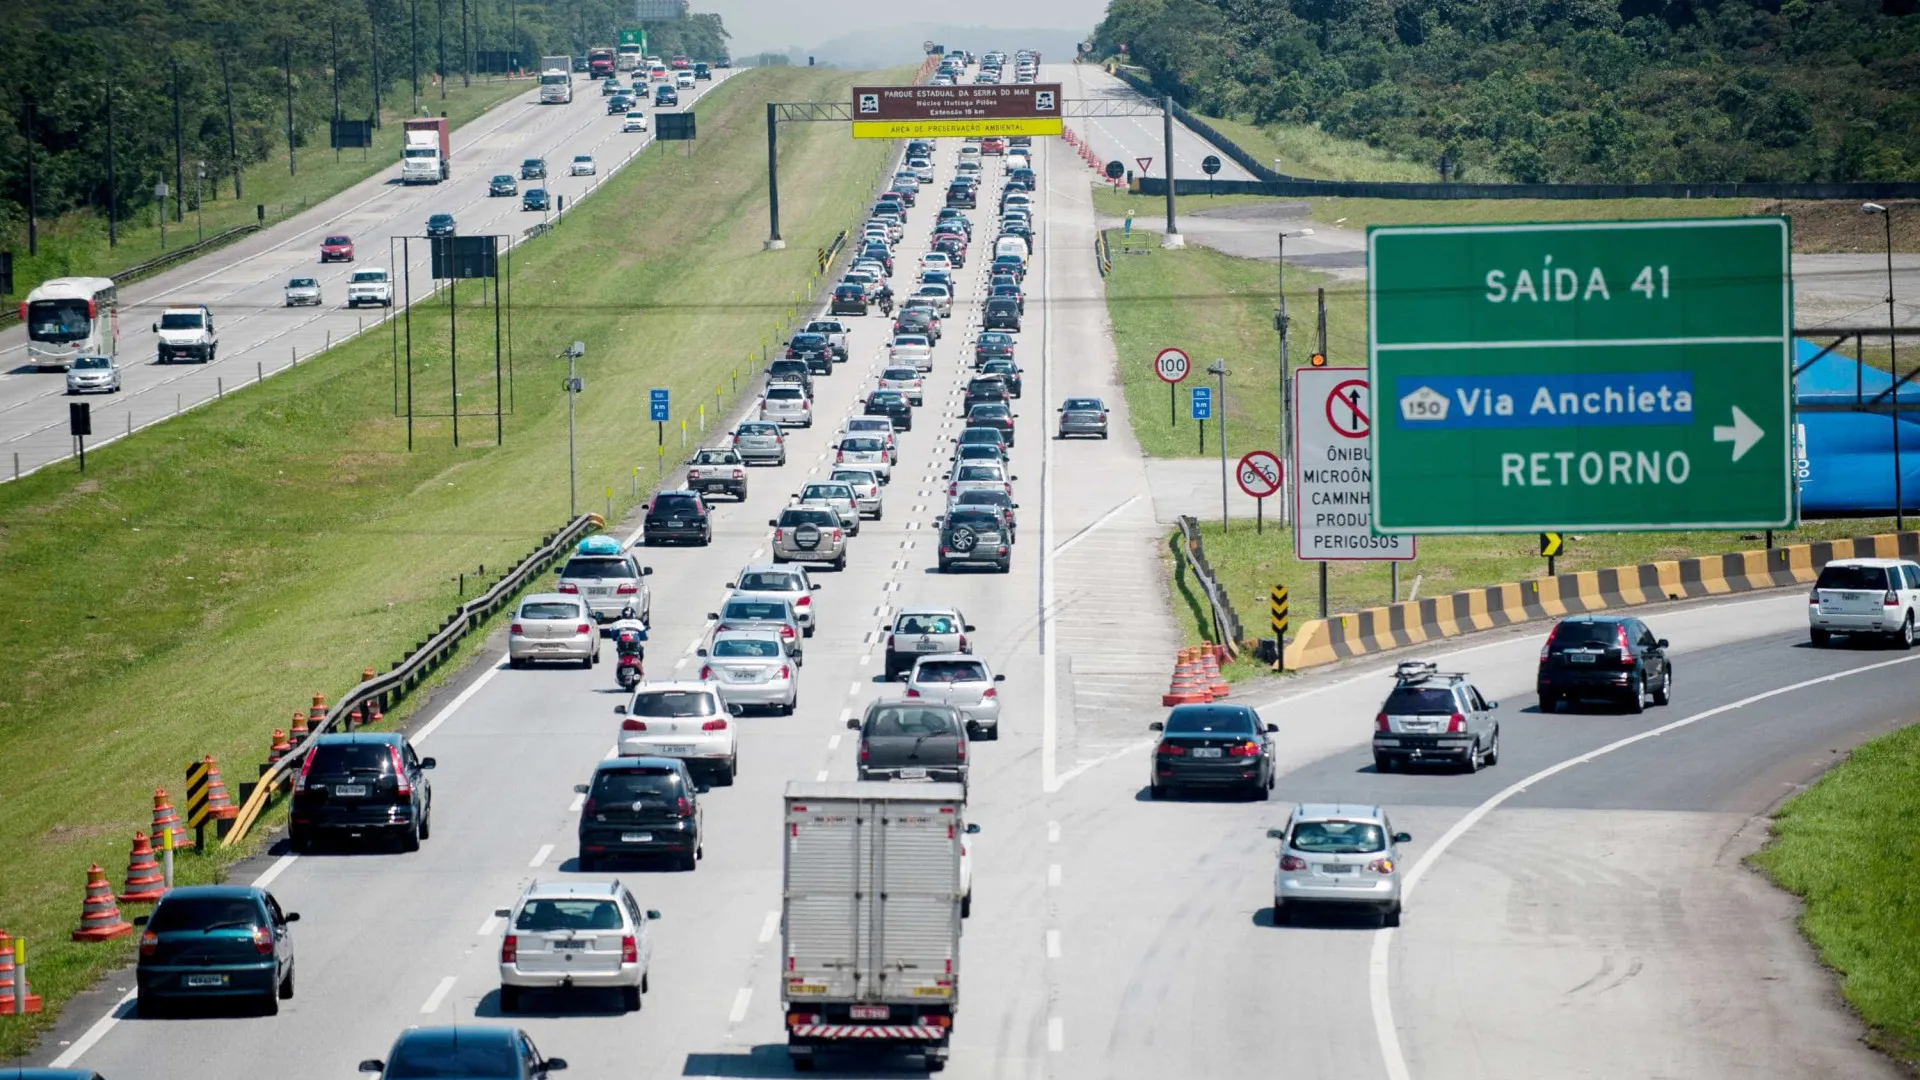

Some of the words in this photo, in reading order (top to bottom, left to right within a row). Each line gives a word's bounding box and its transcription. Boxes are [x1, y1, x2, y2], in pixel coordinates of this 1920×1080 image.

[884, 90, 913, 98] PARQUE
[916, 89, 955, 98] ESTADUAL
[891, 124, 910, 133] ÁREA
[927, 124, 981, 133] PRESERVAÇÃO
[984, 123, 1025, 131] AMBIENTAL
[1485, 254, 1611, 303] SAÍDA
[1630, 264, 1670, 299] 41
[1161, 359, 1185, 372] 100
[1409, 401, 1441, 416] 150
[1456, 388, 1514, 417] Via
[1529, 384, 1693, 416] Anchieta
[1304, 466, 1372, 483] MICROÔN
[1502, 450, 1691, 487] RETORNO
[1312, 491, 1370, 505] CAMINH
[1316, 513, 1372, 527] PRODU
[1314, 534, 1399, 549] PERIGOSOS
